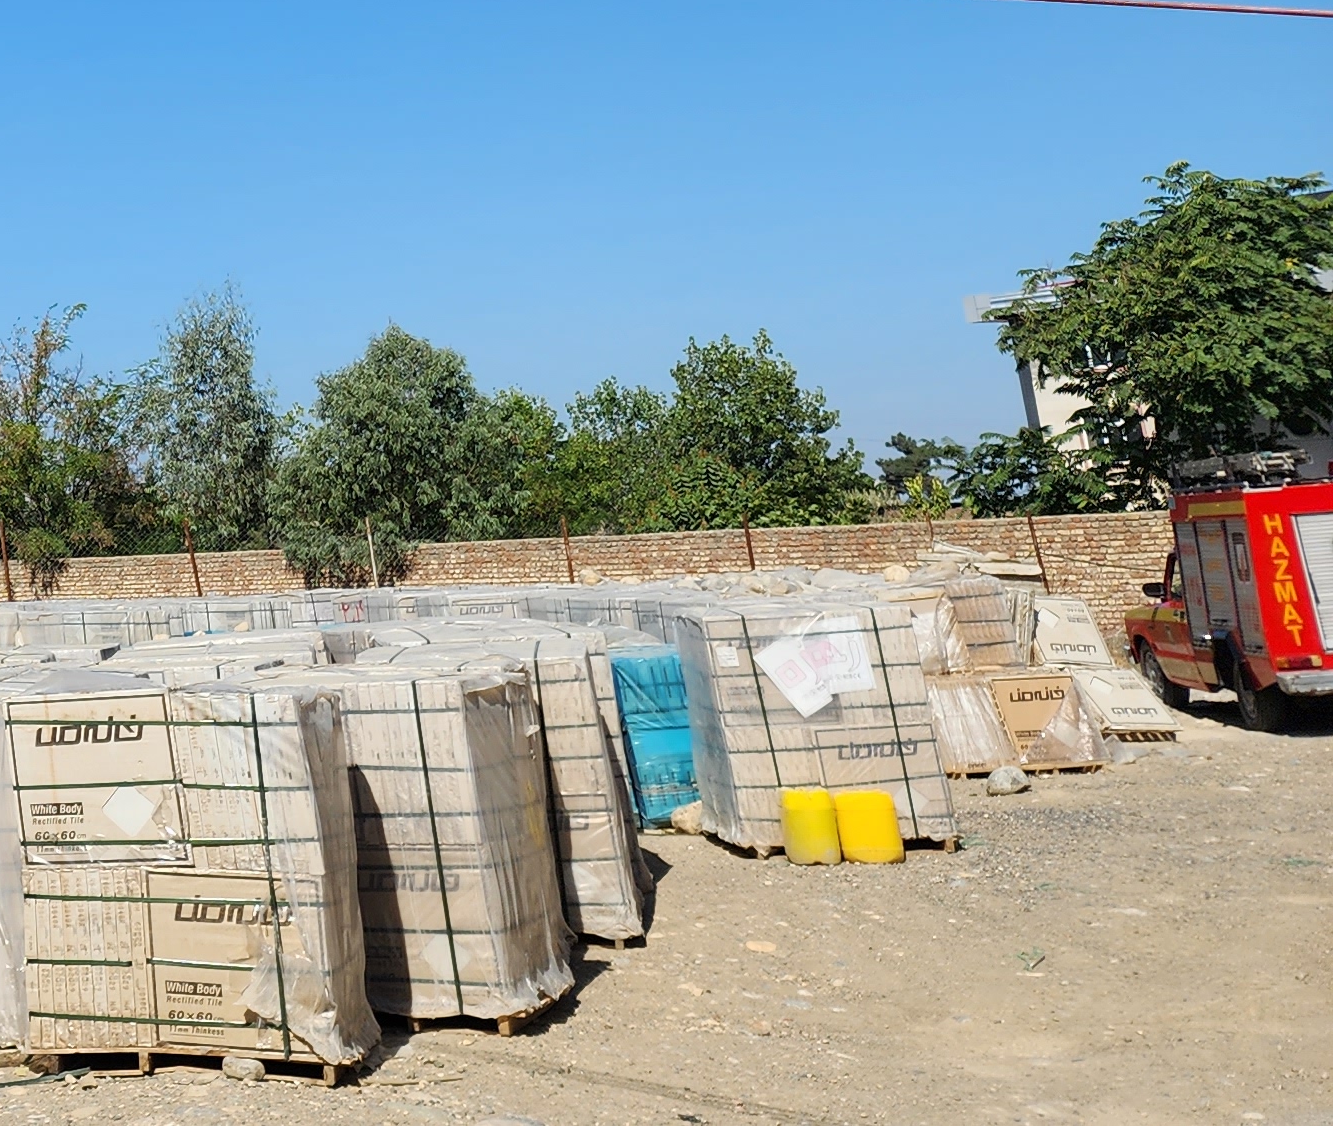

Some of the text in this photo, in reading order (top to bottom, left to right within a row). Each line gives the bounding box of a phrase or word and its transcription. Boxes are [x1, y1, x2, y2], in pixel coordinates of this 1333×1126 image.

[1262, 513, 1303, 647] HAZMAT
[32, 803, 82, 816] White Body
[32, 816, 85, 825] Rectified Tile
[166, 981, 222, 996] White Body
[166, 995, 223, 1007] Rectified Tile
